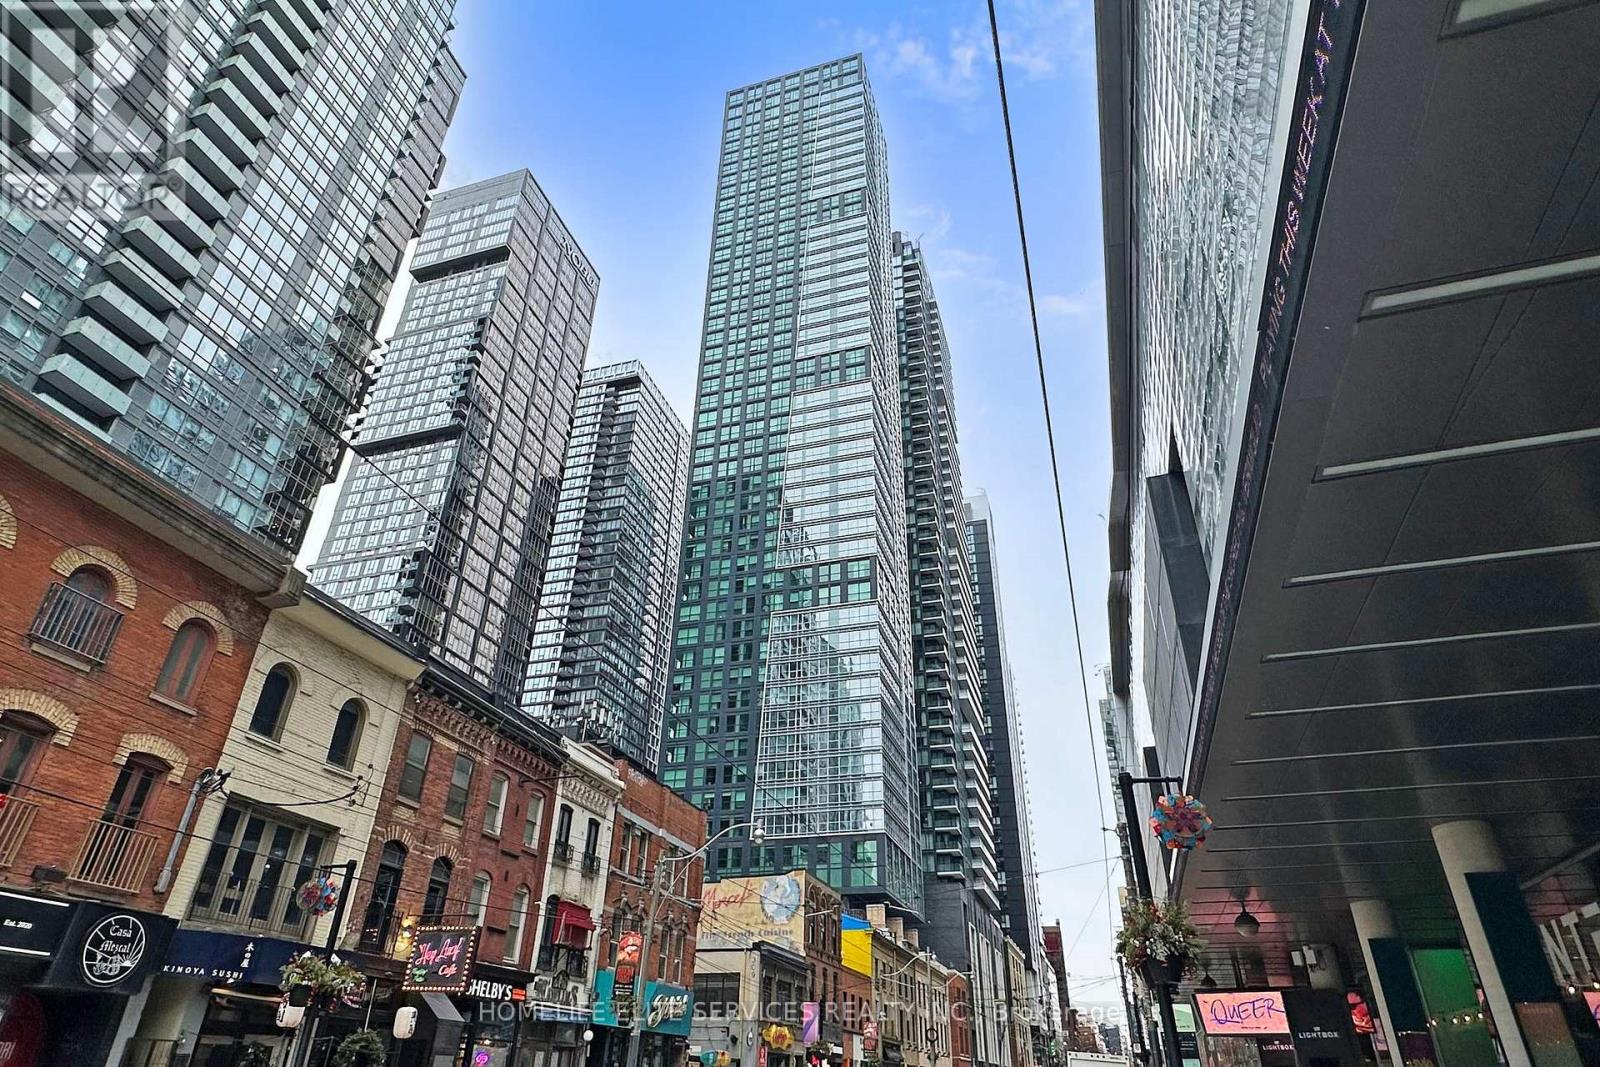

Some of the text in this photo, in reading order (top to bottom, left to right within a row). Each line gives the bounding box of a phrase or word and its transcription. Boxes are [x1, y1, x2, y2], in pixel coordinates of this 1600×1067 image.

[1279, 201, 1299, 277] THIS
[1293, 77, 1323, 203] WEEK
[110, 923, 132, 938] Casa
[99, 939, 132, 954] Mezcal
[240, 941, 255, 968] 木の屋
[162, 964, 244, 980] KINOYA SUSHI
[1210, 997, 1286, 1025] QUEER
[1298, 1031, 1340, 1039] LIGHTBOX
[1262, 1043, 1295, 1051] LIGHTBOX
